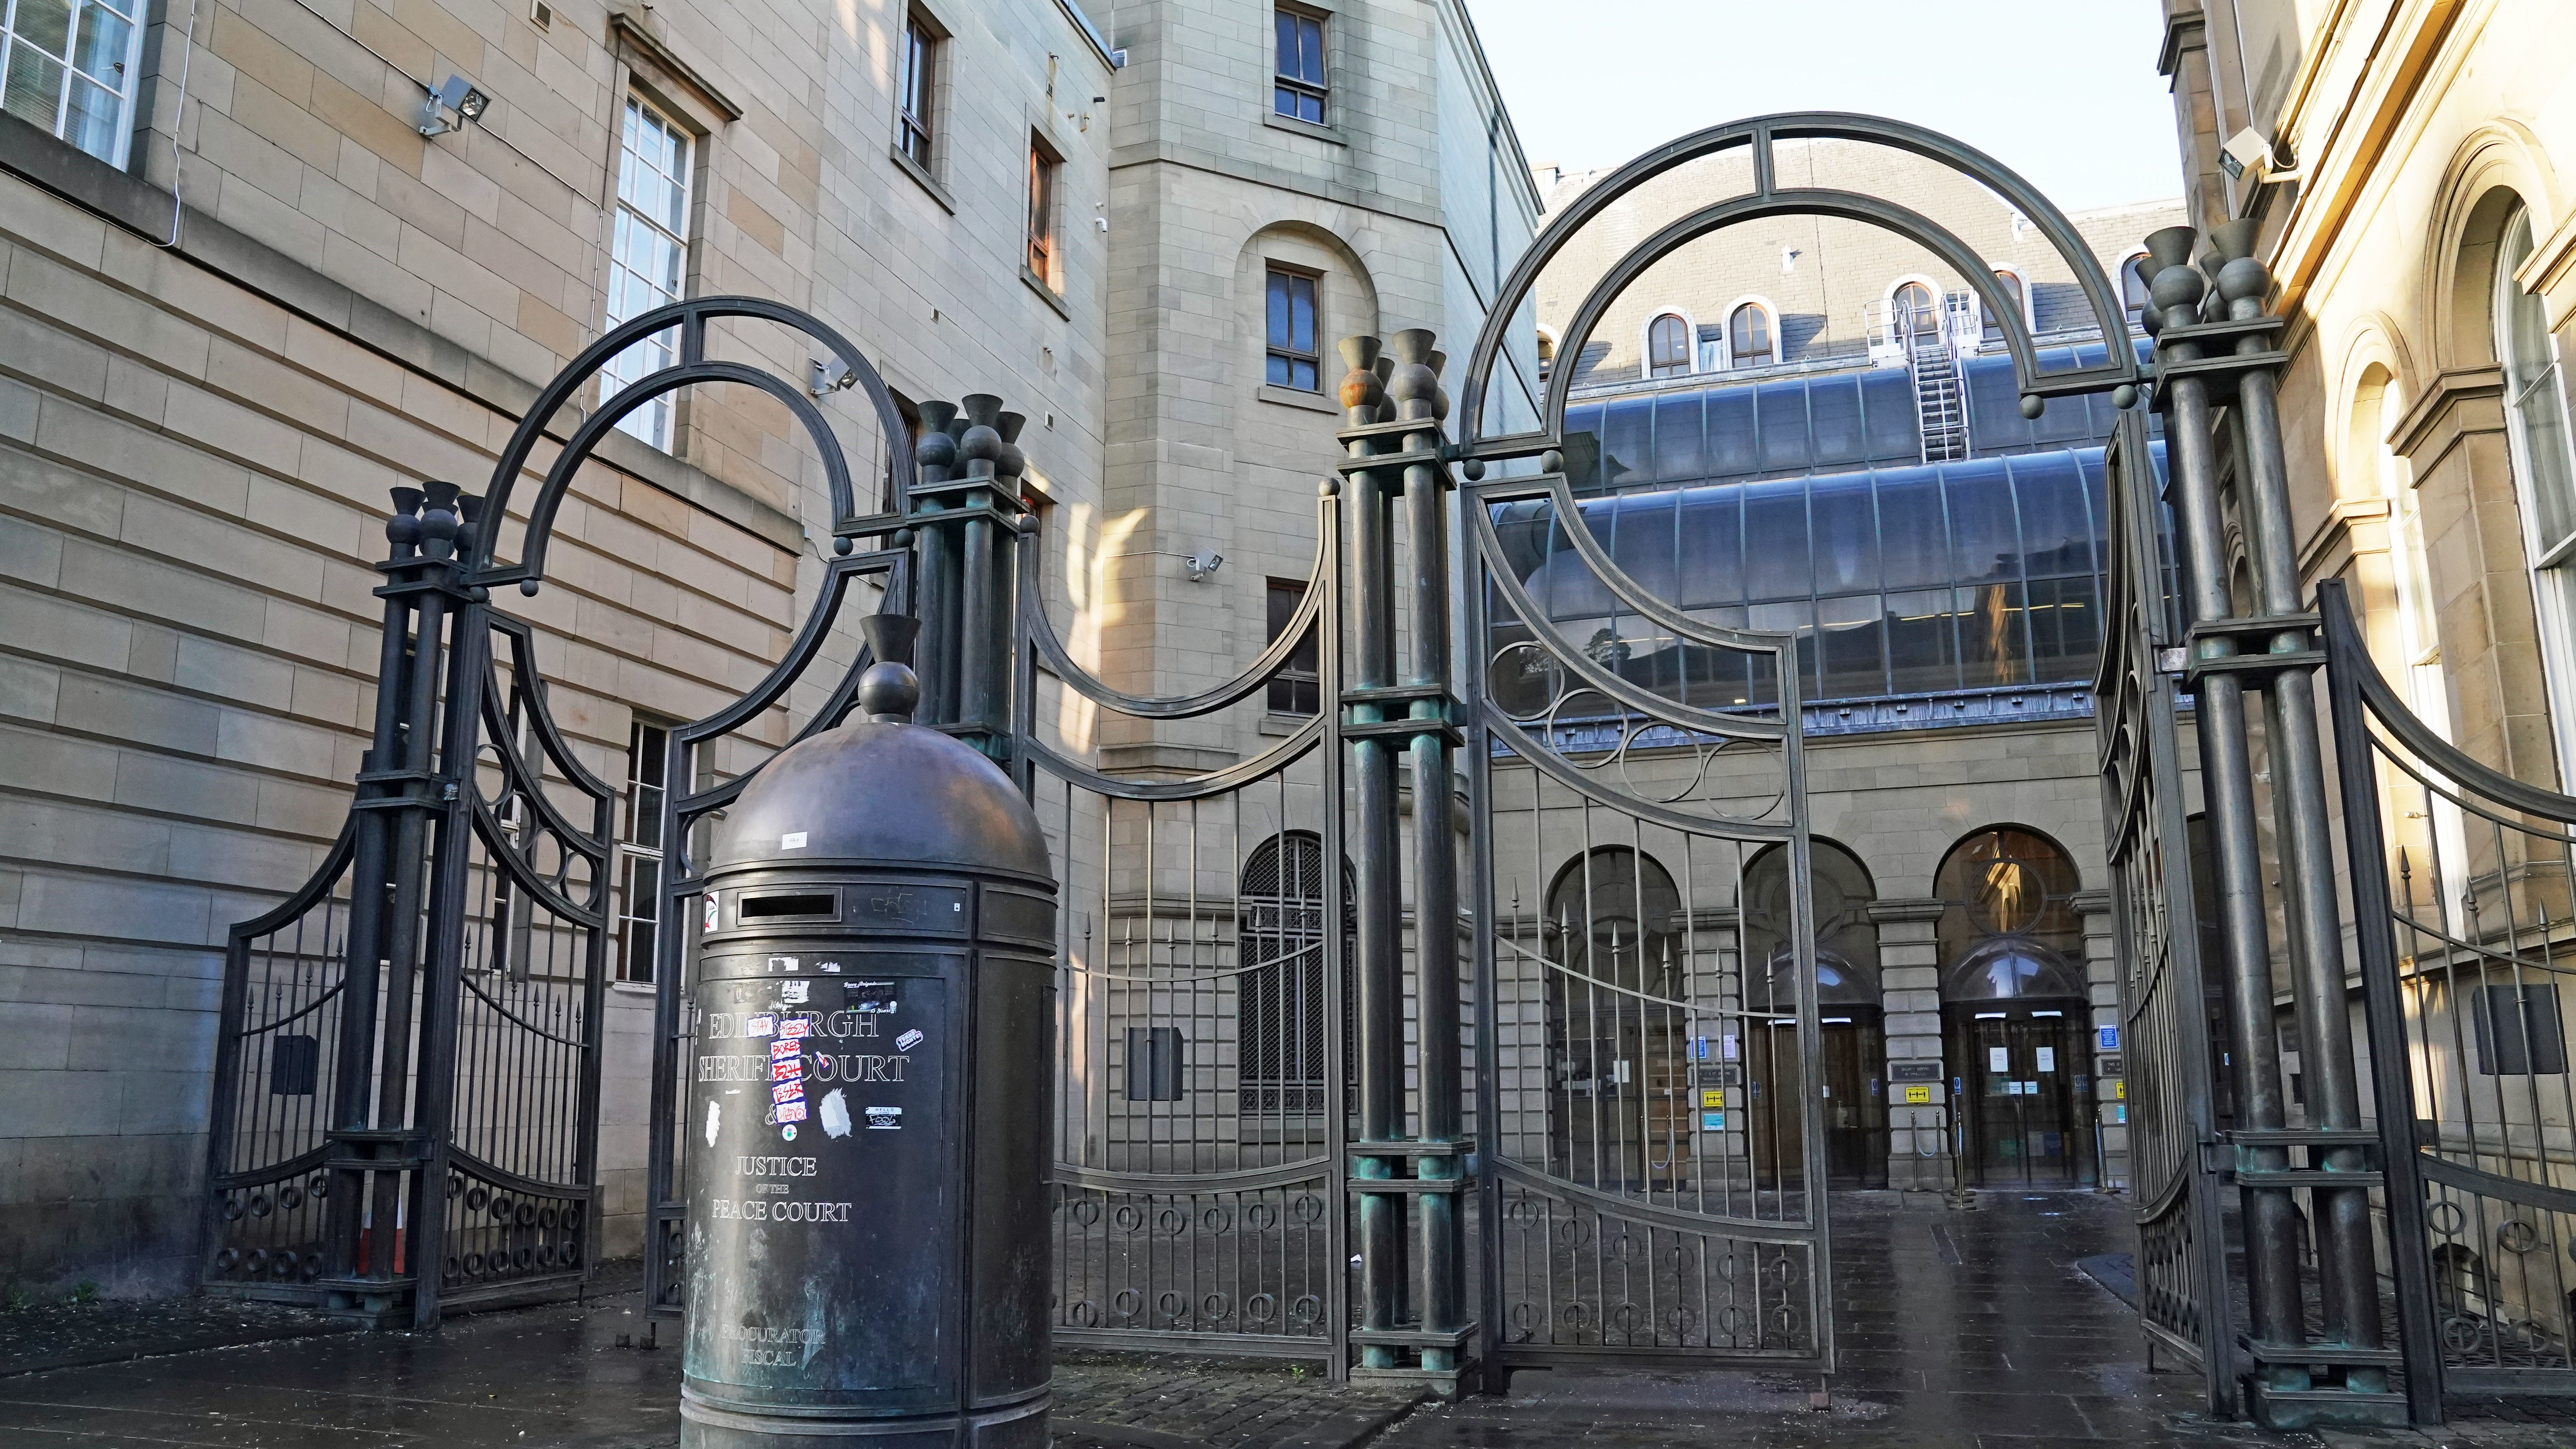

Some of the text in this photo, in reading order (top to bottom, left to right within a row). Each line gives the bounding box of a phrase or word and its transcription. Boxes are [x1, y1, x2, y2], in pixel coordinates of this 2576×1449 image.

[751, 1019, 769, 1034] STAY
[773, 1040, 801, 1059] BORED
[801, 1054, 909, 1082] COURT
[735, 1156, 817, 1176] JUSTICE
[755, 1184, 790, 1194] OF THE
[712, 1199, 852, 1222] PEACE COURT
[721, 1324, 826, 1344] PROCURATOR
[741, 1348, 797, 1366] FISCAL
